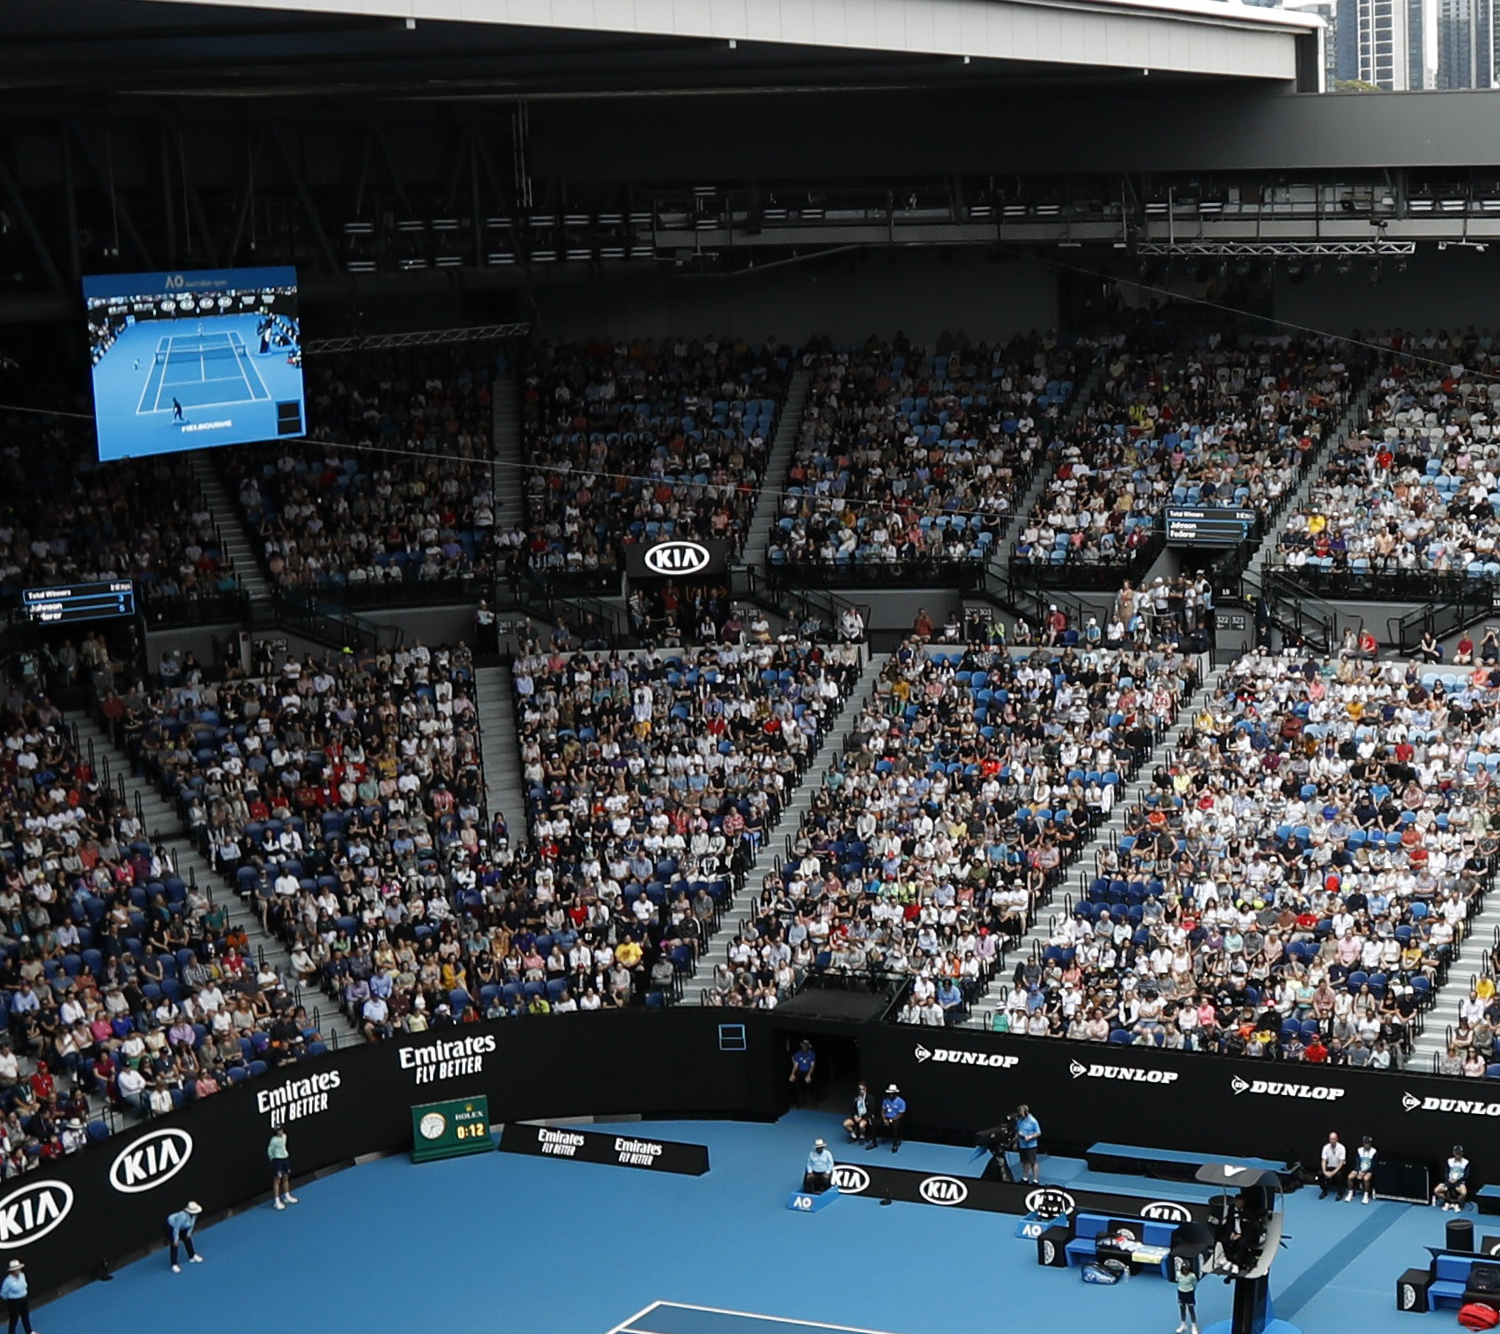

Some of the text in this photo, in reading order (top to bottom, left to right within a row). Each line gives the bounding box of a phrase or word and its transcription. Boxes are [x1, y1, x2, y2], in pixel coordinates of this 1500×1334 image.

[1170, 521, 1197, 529] Johnson
[1170, 530, 1196, 538] Federer
[655, 548, 699, 568] KIA
[399, 1034, 496, 1070] Emirates
[932, 1049, 1019, 1068] DUNLOP
[415, 1055, 483, 1085] FLY BETTER
[1087, 1065, 1179, 1084] DUNLOP
[257, 1070, 341, 1114] Emirates
[1250, 1080, 1345, 1100] DUNLOP
[271, 1092, 328, 1129] FLY BETTER
[454, 1110, 484, 1121] ROLEX
[456, 1123, 485, 1139] 0:12
[538, 1128, 585, 1147] Emirates
[541, 1142, 576, 1156] FLY BETTER
[614, 1137, 662, 1156] Emirates
[123, 1137, 181, 1185] KIA
[618, 1151, 654, 1166] FLY BETTER
[831, 1170, 861, 1188] KIA
[927, 1181, 958, 1200] KIA
[794, 1197, 812, 1208] AO
[1150, 1207, 1181, 1221] KIA
[1022, 1225, 1042, 1236] AO
